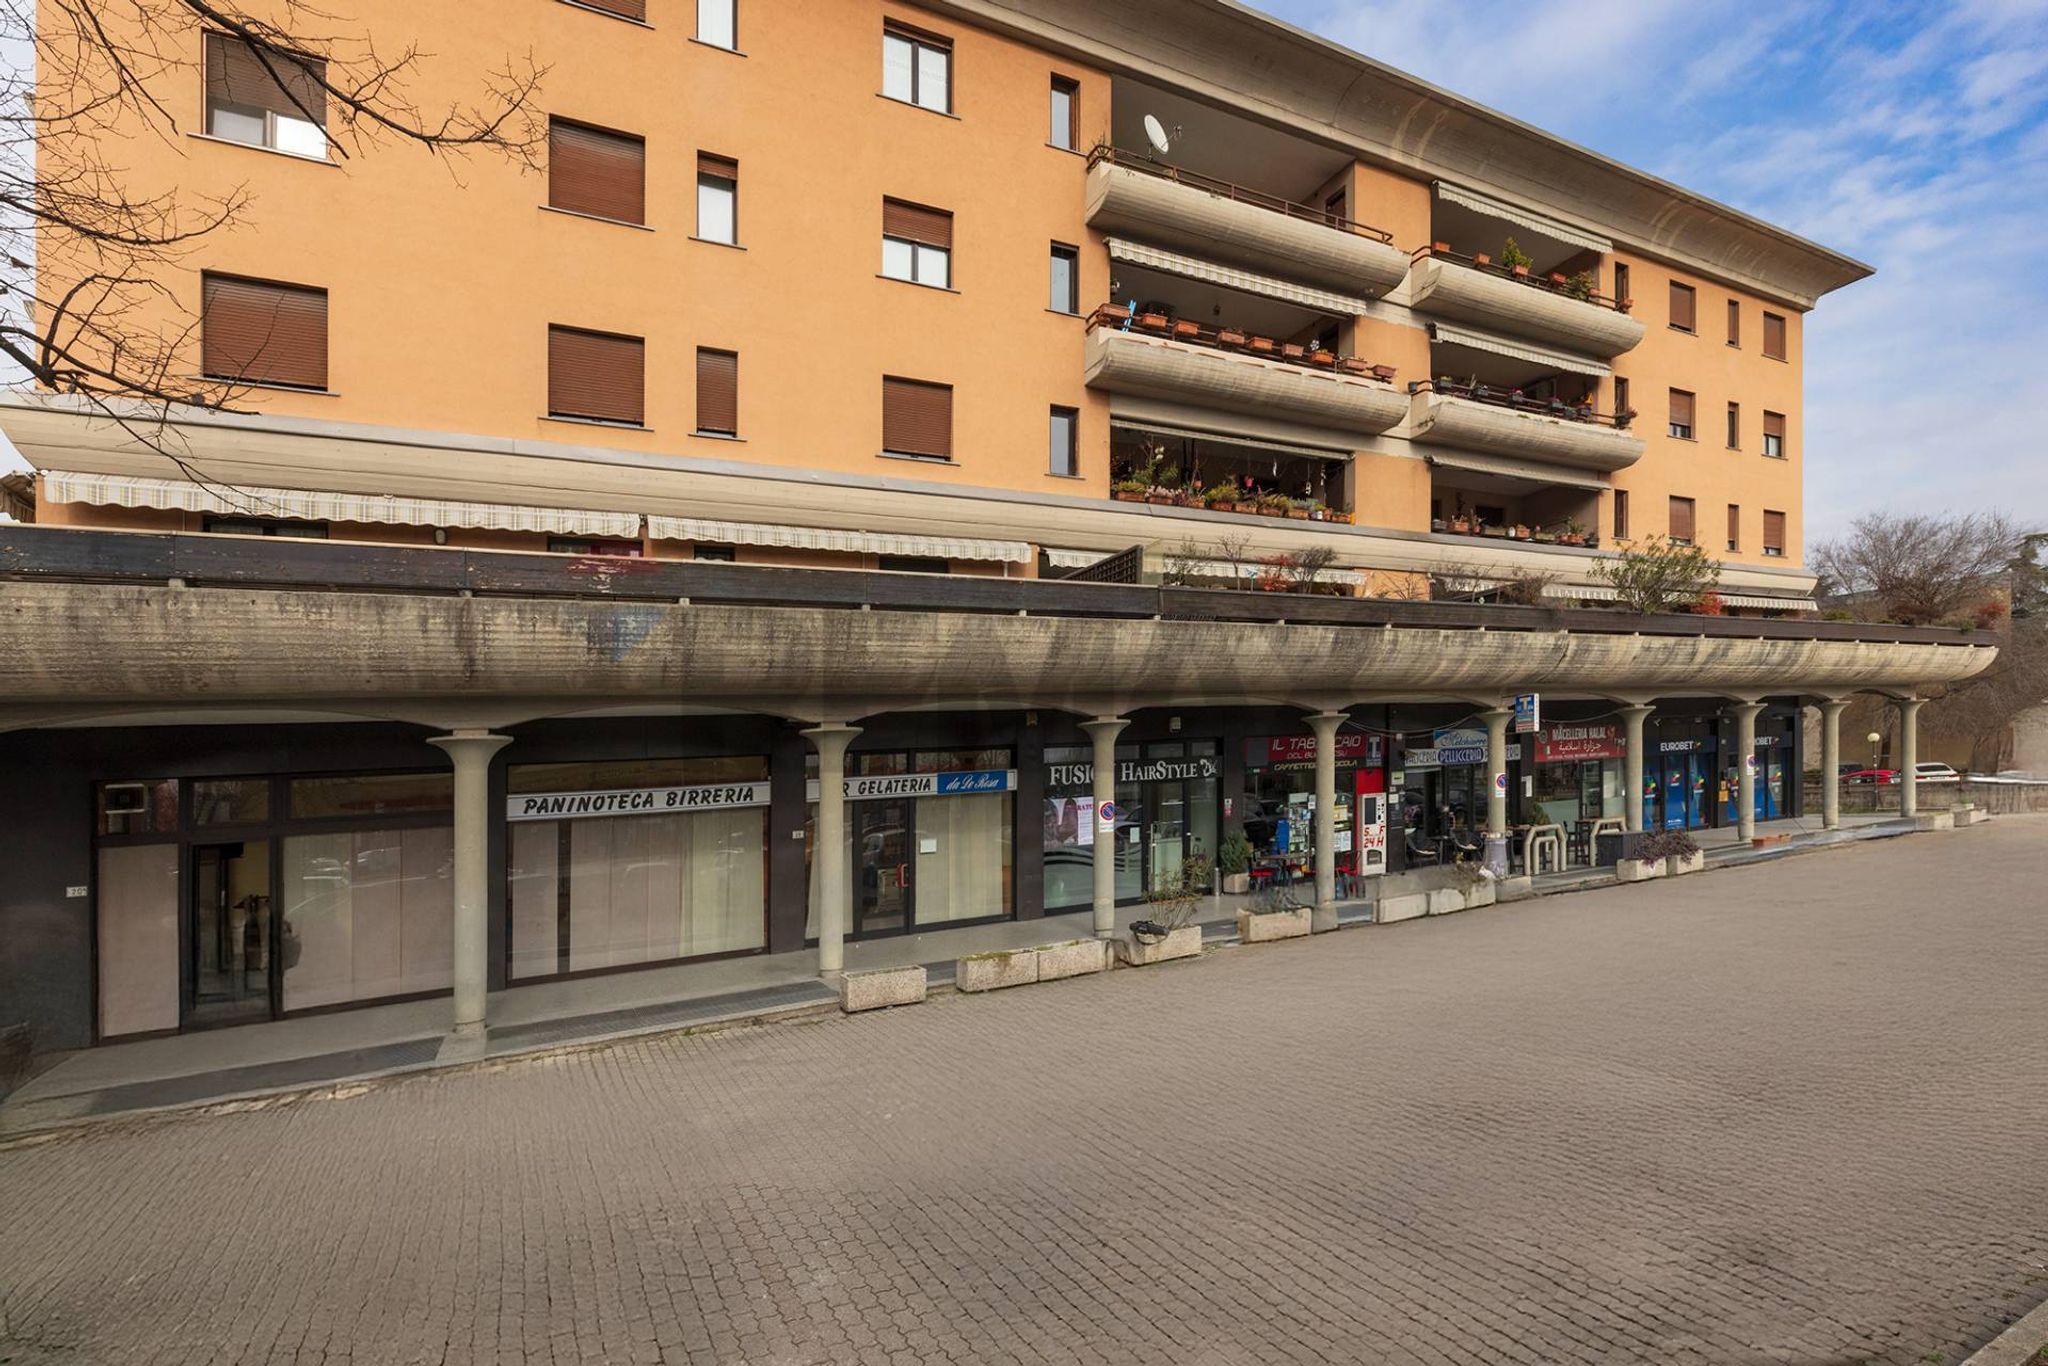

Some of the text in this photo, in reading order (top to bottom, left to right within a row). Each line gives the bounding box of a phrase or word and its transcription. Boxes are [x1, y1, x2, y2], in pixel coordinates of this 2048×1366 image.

[1552, 727, 1587, 741] MACELLERIA
[1755, 736, 1772, 745] OBET
[1272, 735, 1361, 751] IL TABCAIO
[1660, 741, 1694, 752] EUROBET
[1440, 749, 1482, 763] PELLICCERIA
[1049, 764, 1095, 786] FUSI
[857, 778, 931, 796] GELATERIA
[523, 786, 755, 815] PANINOTECA BIRRERIA
